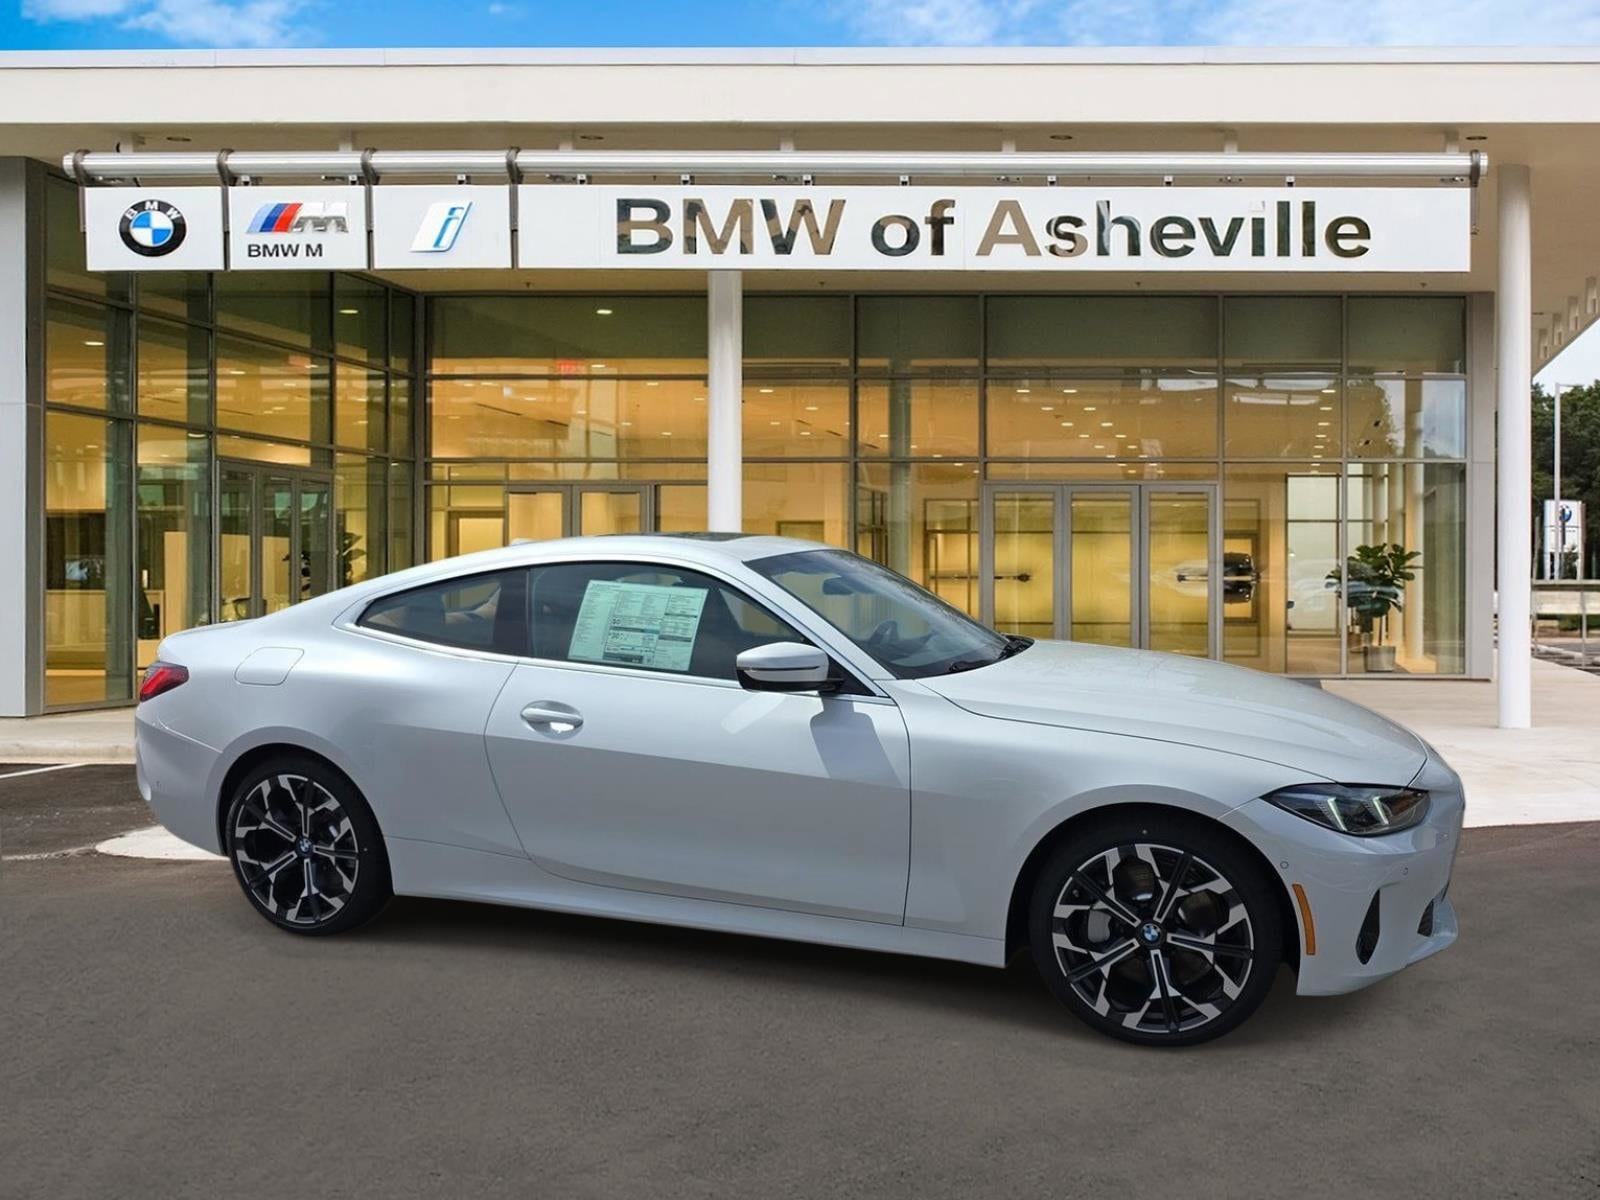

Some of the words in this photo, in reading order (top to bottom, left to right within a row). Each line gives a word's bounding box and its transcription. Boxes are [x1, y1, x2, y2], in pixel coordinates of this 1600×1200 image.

[125, 201, 181, 220] BMW
[616, 198, 846, 256] BMW
[870, 199, 955, 257] of
[975, 200, 1371, 258] Asheville
[247, 244, 300, 258] BMW
[305, 244, 323, 258] M
